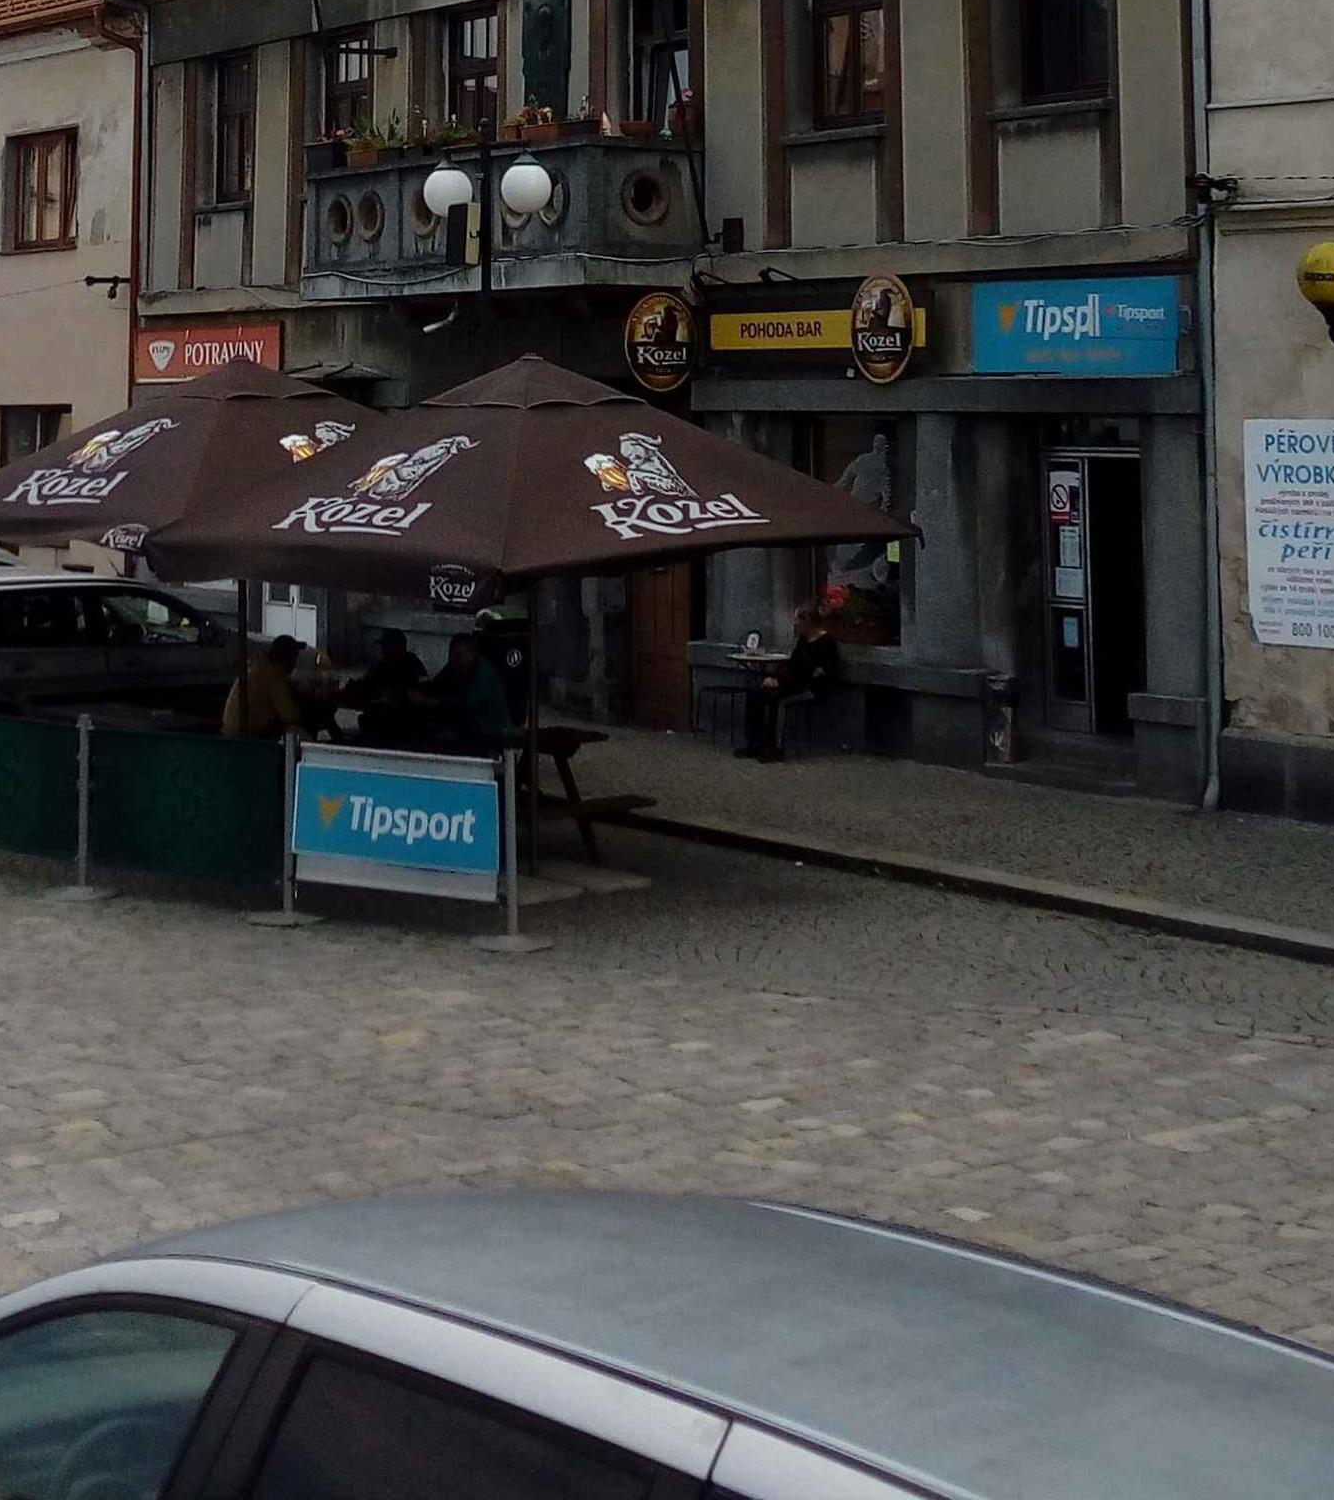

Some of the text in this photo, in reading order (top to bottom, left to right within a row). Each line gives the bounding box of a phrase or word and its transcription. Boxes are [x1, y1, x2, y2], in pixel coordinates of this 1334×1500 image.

[740, 321, 823, 339] POHODA BAR
[857, 331, 902, 353] Kozel
[184, 340, 264, 366] POTRAVINY
[636, 346, 687, 366] Kozel
[2, 469, 129, 505] Kozel
[271, 497, 432, 535] Kozel
[590, 493, 768, 540] Kozel
[1281, 542, 1334, 562] peří
[430, 576, 476, 602] Kozel
[350, 795, 476, 845] Tipsport
